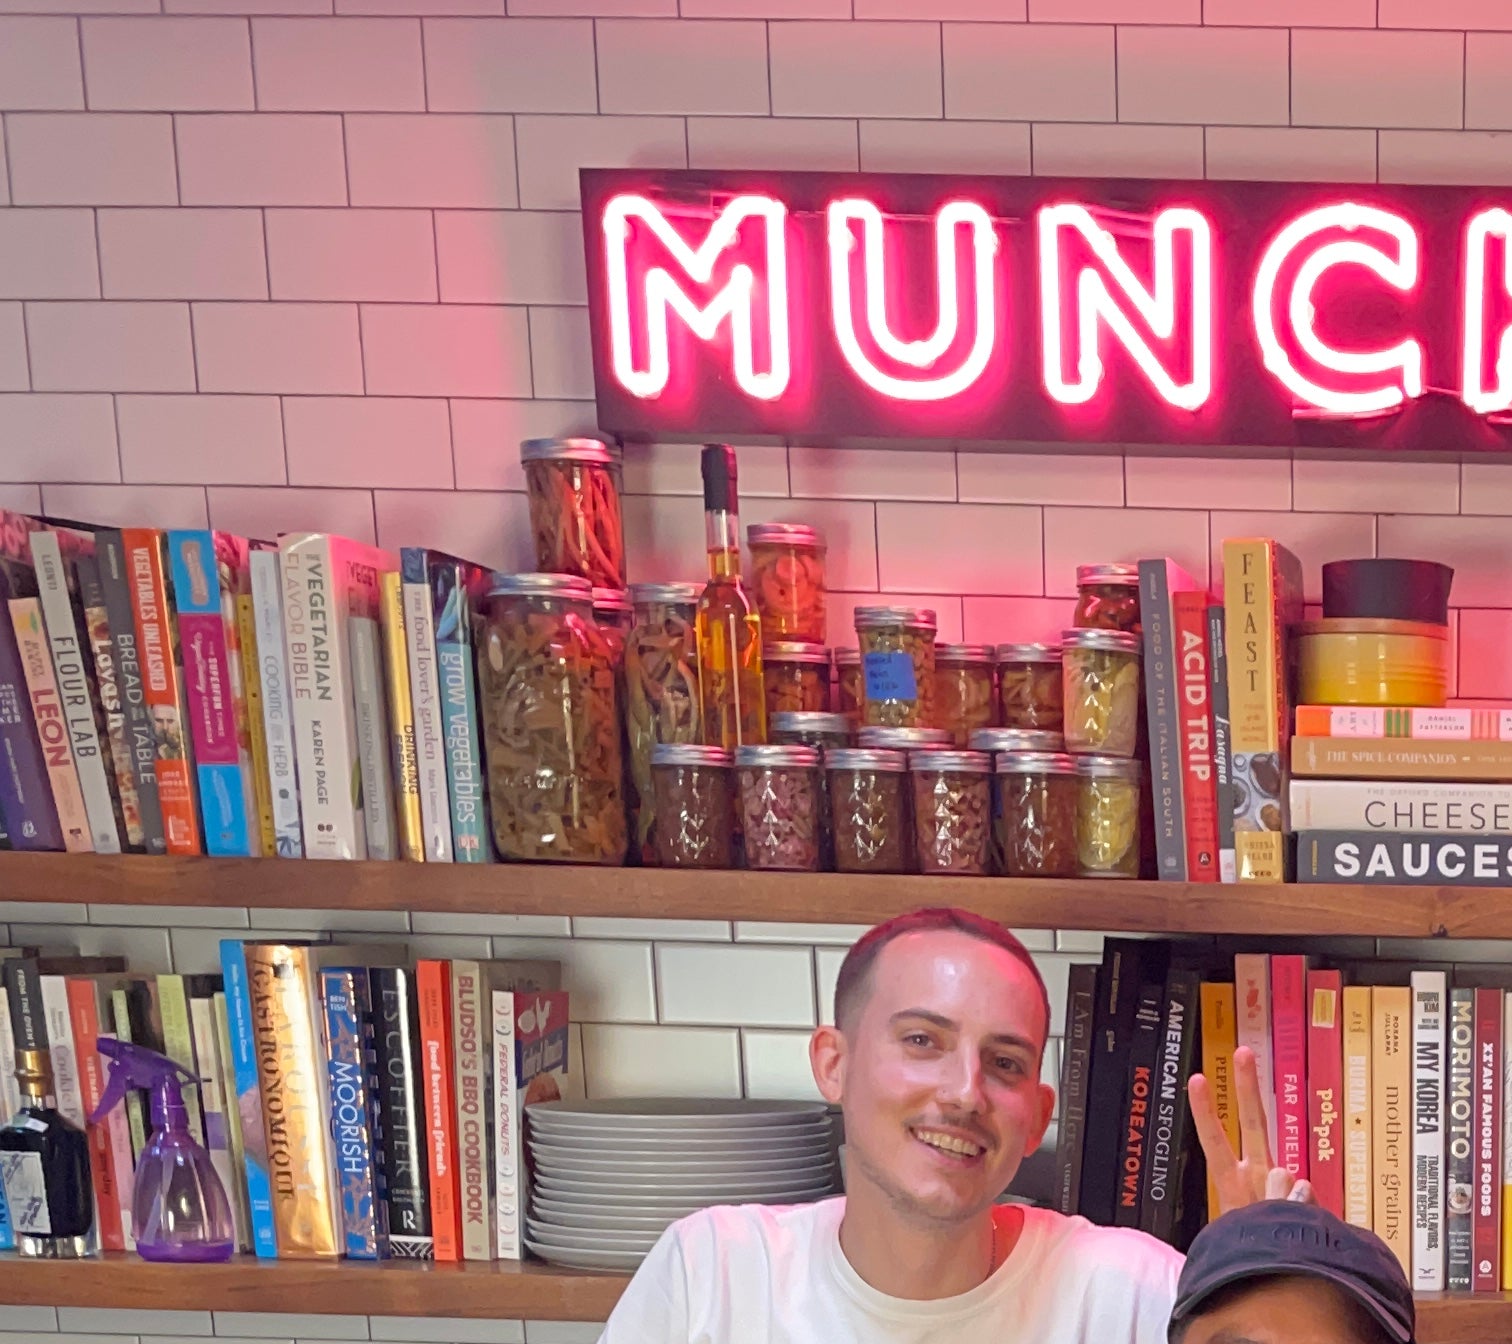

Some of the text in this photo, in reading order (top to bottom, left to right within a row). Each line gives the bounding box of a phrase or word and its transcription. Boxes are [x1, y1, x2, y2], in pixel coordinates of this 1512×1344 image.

[132, 547, 167, 691] VEGETABLES UNLEASHED
[286, 552, 312, 699] FLAVOR BIBLE
[307, 563, 332, 701] VEGETARIAN
[414, 615, 431, 651] food
[1152, 613, 1164, 651] FOOD
[1241, 552, 1259, 693] FEAST
[53, 636, 97, 758] FLOUR LAB
[95, 640, 125, 729] Lavash
[207, 658, 222, 709] SUPERFUN
[264, 655, 284, 719] COOKING
[417, 656, 434, 704] lover's
[1155, 661, 1165, 680] OF
[1157, 689, 1167, 715] THE
[1182, 630, 1211, 781] ACID TRIP
[32, 688, 70, 767] LEON
[117, 634, 156, 785] BREAD TABLE
[418, 707, 438, 760] garden
[440, 651, 481, 823] grow vegetables
[311, 719, 329, 805] KAREN PAGE
[403, 724, 418, 795] DRINKING
[1159, 722, 1171, 780] ITALIAN
[1213, 714, 1229, 785] Lasagna
[1326, 751, 1457, 764] THE SPICE COMPANION
[1163, 787, 1174, 837] SOUTH
[1365, 801, 1510, 831] CHEESE
[1433, 790, 1493, 798] COMPANION
[15, 968, 35, 1040] FROM THE OVEN
[1075, 1005, 1090, 1039] Am
[87, 1056, 99, 1109] VIETNAM
[252, 969, 295, 1201] GASTRONOMIQUE
[382, 989, 412, 1176] ESCOFFIER
[427, 1039, 441, 1070] food
[1070, 1048, 1084, 1097] From
[1215, 1055, 1229, 1120] PEPPERS
[1348, 1055, 1367, 1113] BURMA
[1416, 1041, 1439, 1135] MY KOREA
[1451, 1000, 1473, 1159] MORIMOTO
[333, 1061, 363, 1172] MOORISH
[430, 1072, 445, 1127] between
[457, 975, 485, 1224] BLUDSO'S BBQ COOKBOOK
[499, 1042, 512, 1155] FEDERAL DONUTS
[1065, 1105, 1083, 1153] Here
[1150, 999, 1184, 1201] AMERICAN SFOGLINO
[1284, 1073, 1300, 1174] FAR AFIELD
[1313, 1088, 1338, 1161] pok pok
[1481, 1094, 1493, 1159] FAMOUS
[433, 1129, 448, 1176] friends
[1121, 1066, 1151, 1207] KOREATOWN
[1380, 1085, 1403, 1240] mother grains
[1349, 1130, 1367, 1225] SUPERSTAR
[1416, 1154, 1428, 1229] MODERN RECIPES
[1426, 1154, 1439, 1251] TRADITIONAL FLAVORS,
[1480, 1163, 1493, 1216] FOODS
